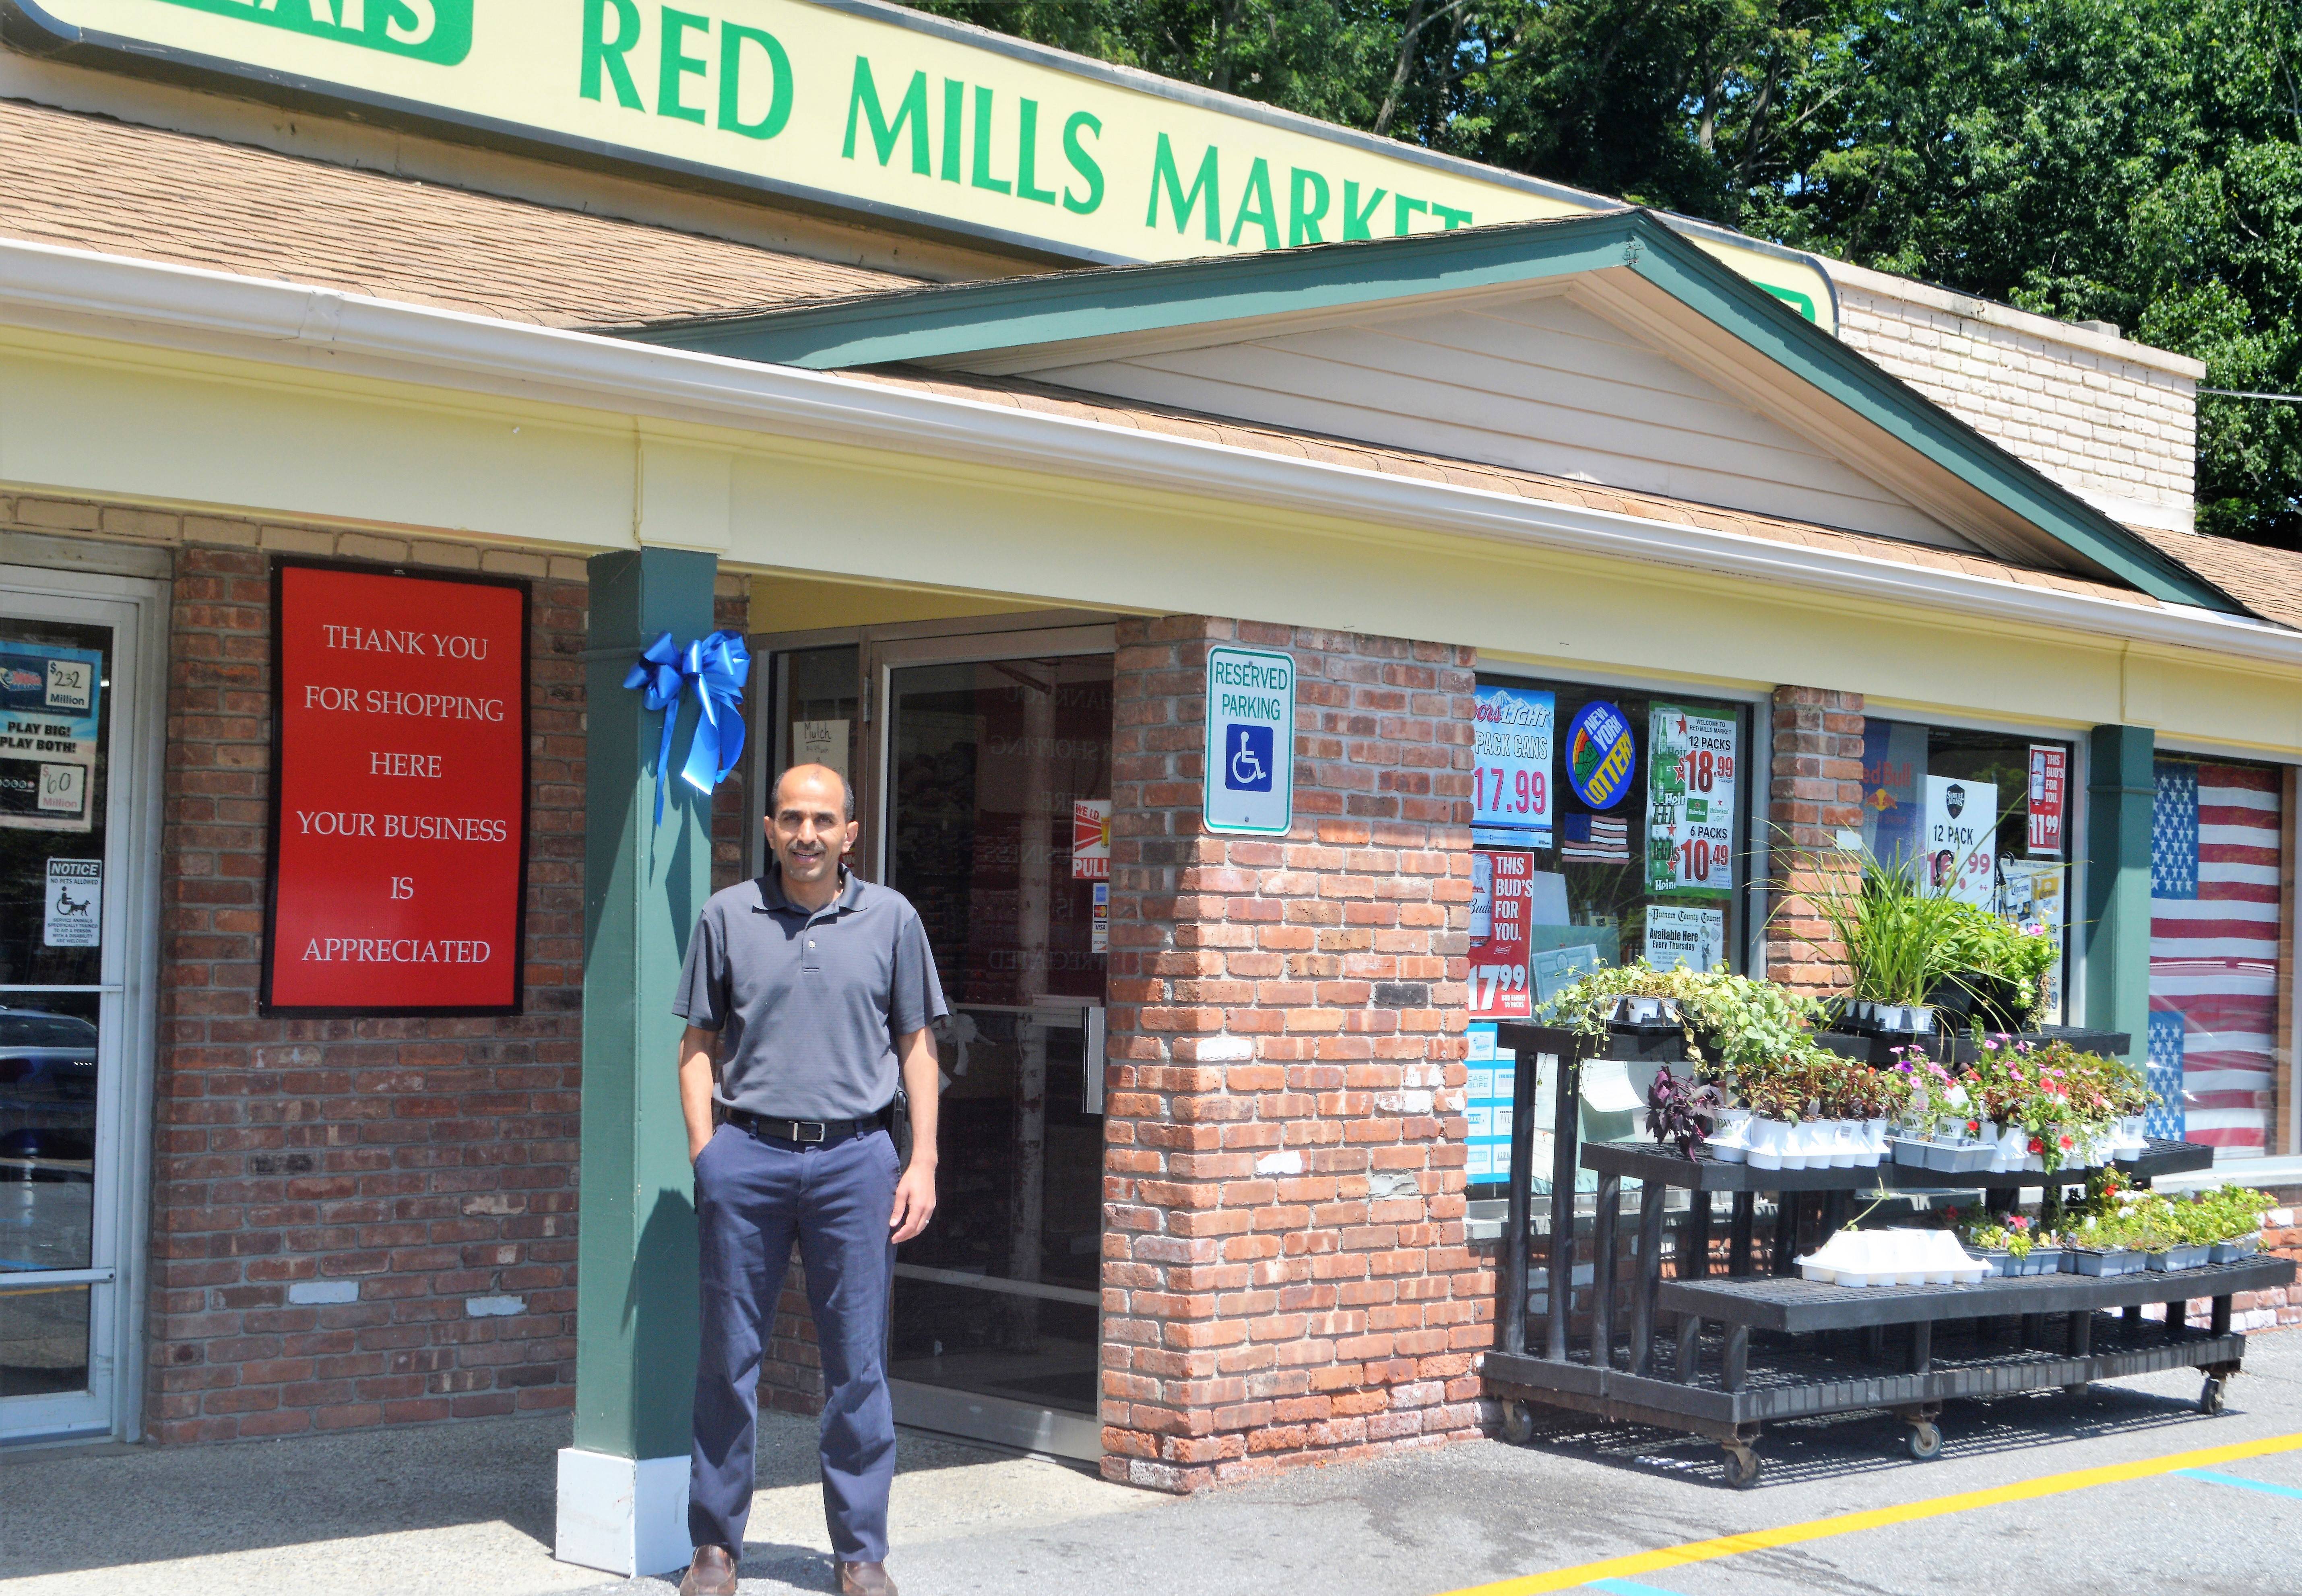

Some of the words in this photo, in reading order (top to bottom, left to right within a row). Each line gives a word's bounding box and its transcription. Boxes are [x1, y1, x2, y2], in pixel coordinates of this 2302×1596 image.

[580, 0, 793, 140] RED
[842, 55, 1105, 215] MILLS
[1145, 131, 1473, 250] MARK
[323, 625, 425, 656] THANK
[432, 634, 488, 660] YOU
[1216, 662, 1288, 690] RESERVED
[51, 694, 84, 705] Million
[304, 685, 359, 711] FOR
[366, 690, 504, 721] SHOPPING
[1222, 694, 1280, 720] PARKING
[1475, 704, 1502, 723] ors
[1502, 706, 1550, 728] LIGHT
[1584, 707, 1609, 735] NEW
[8, 721, 42, 734] PLAY
[45, 725, 71, 737] BIG!
[805, 722, 831, 739] Mulch
[1593, 714, 1623, 752] YORK
[0, 736, 33, 749] PLAY
[36, 739, 76, 753] BOTH!
[1475, 731, 1510, 757] PACK
[1514, 735, 1547, 759] CANS
[1689, 736, 1699, 747] 12
[1702, 737, 1730, 750] PACKS
[370, 752, 442, 778] HERE
[1584, 729, 1633, 805] LOTTERY
[2047, 754, 2060, 765] THIS
[1862, 759, 1881, 784] ed
[1883, 762, 1911, 787] Bull
[2046, 767, 2064, 778] BUD'S
[1474, 766, 1546, 814] 17.99
[2046, 779, 2057, 790] FOR
[43, 798, 77, 808] Million
[1947, 790, 1964, 800] SAMUEL
[1948, 798, 1964, 806] ADAMS
[2045, 792, 2058, 803] YOU.
[1076, 804, 1088, 816] WE
[1089, 809, 1099, 821] I.D.
[296, 810, 376, 837] YOUR
[384, 814, 507, 842] BUSINESS
[1690, 826, 1695, 836] 6
[1698, 827, 1727, 839] PACKS
[1934, 825, 1943, 842] 12
[1948, 826, 1974, 845] PACK
[52, 863, 98, 876] NOTICE
[1072, 859, 1110, 876] PULL
[1496, 856, 1525, 875] THIS
[390, 876, 414, 900] IS
[1496, 878, 1533, 897] BUD'S
[1495, 901, 1519, 919] FOR
[1652, 908, 1676, 924] Putnam
[1678, 910, 1699, 922] County
[1701, 912, 1721, 924] Courier
[1494, 923, 1522, 941] YOU.
[1650, 928, 1681, 941] Available
[1683, 930, 1698, 942] Here
[302, 938, 491, 964] APPRECIATED
[1653, 940, 1667, 949] Every
[1669, 941, 1695, 951] Thursday
